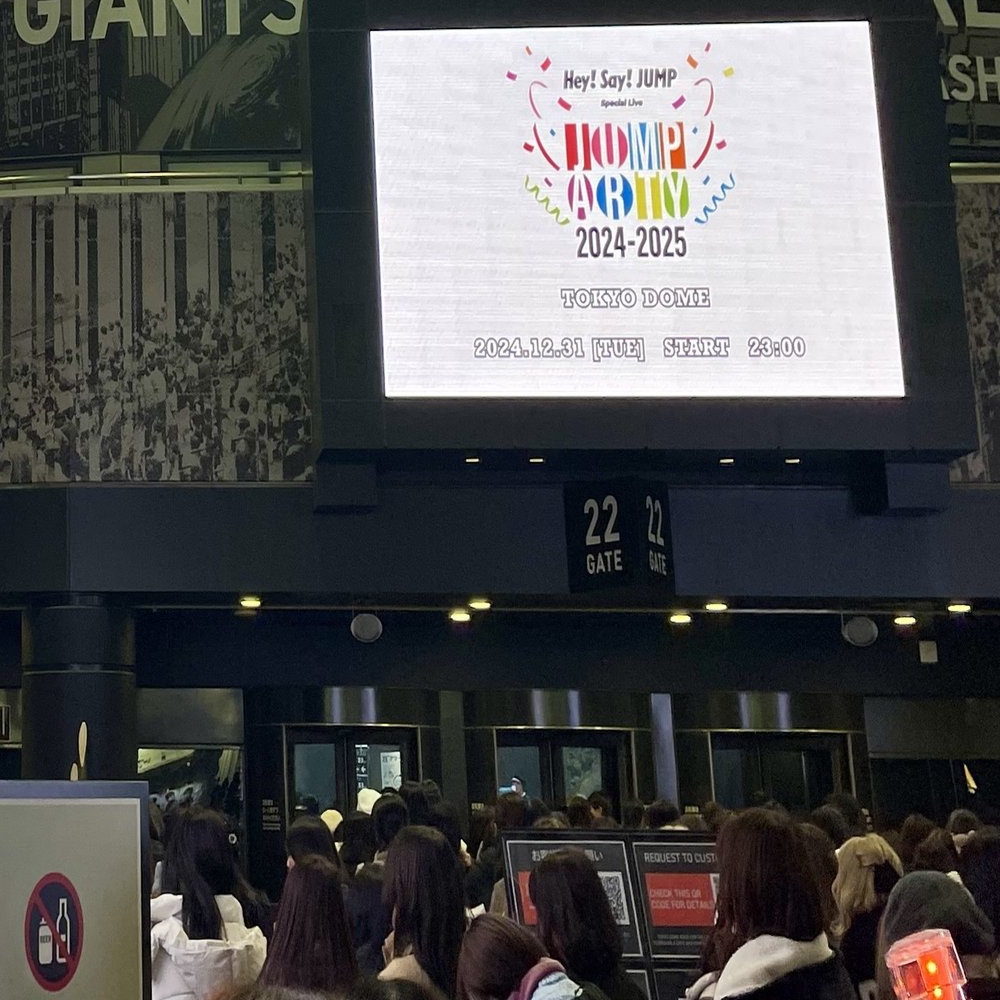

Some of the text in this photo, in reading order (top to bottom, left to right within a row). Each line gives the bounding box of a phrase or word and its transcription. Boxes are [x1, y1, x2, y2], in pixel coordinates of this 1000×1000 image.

[563, 68, 678, 93] Hey! Say! JUMP
[576, 226, 687, 258] 2024-2025
[561, 287, 711, 309] TOKYO DOME
[474, 336, 807, 362] 2024.12.31 [TUE] START 23:00
[583, 495, 620, 546] 22
[646, 495, 665, 547] 22
[586, 549, 623, 575] GATE
[649, 550, 667, 576] GATE
[644, 852, 718, 863] REQUEST TO CUST
[674, 889, 691, 898] THIS
